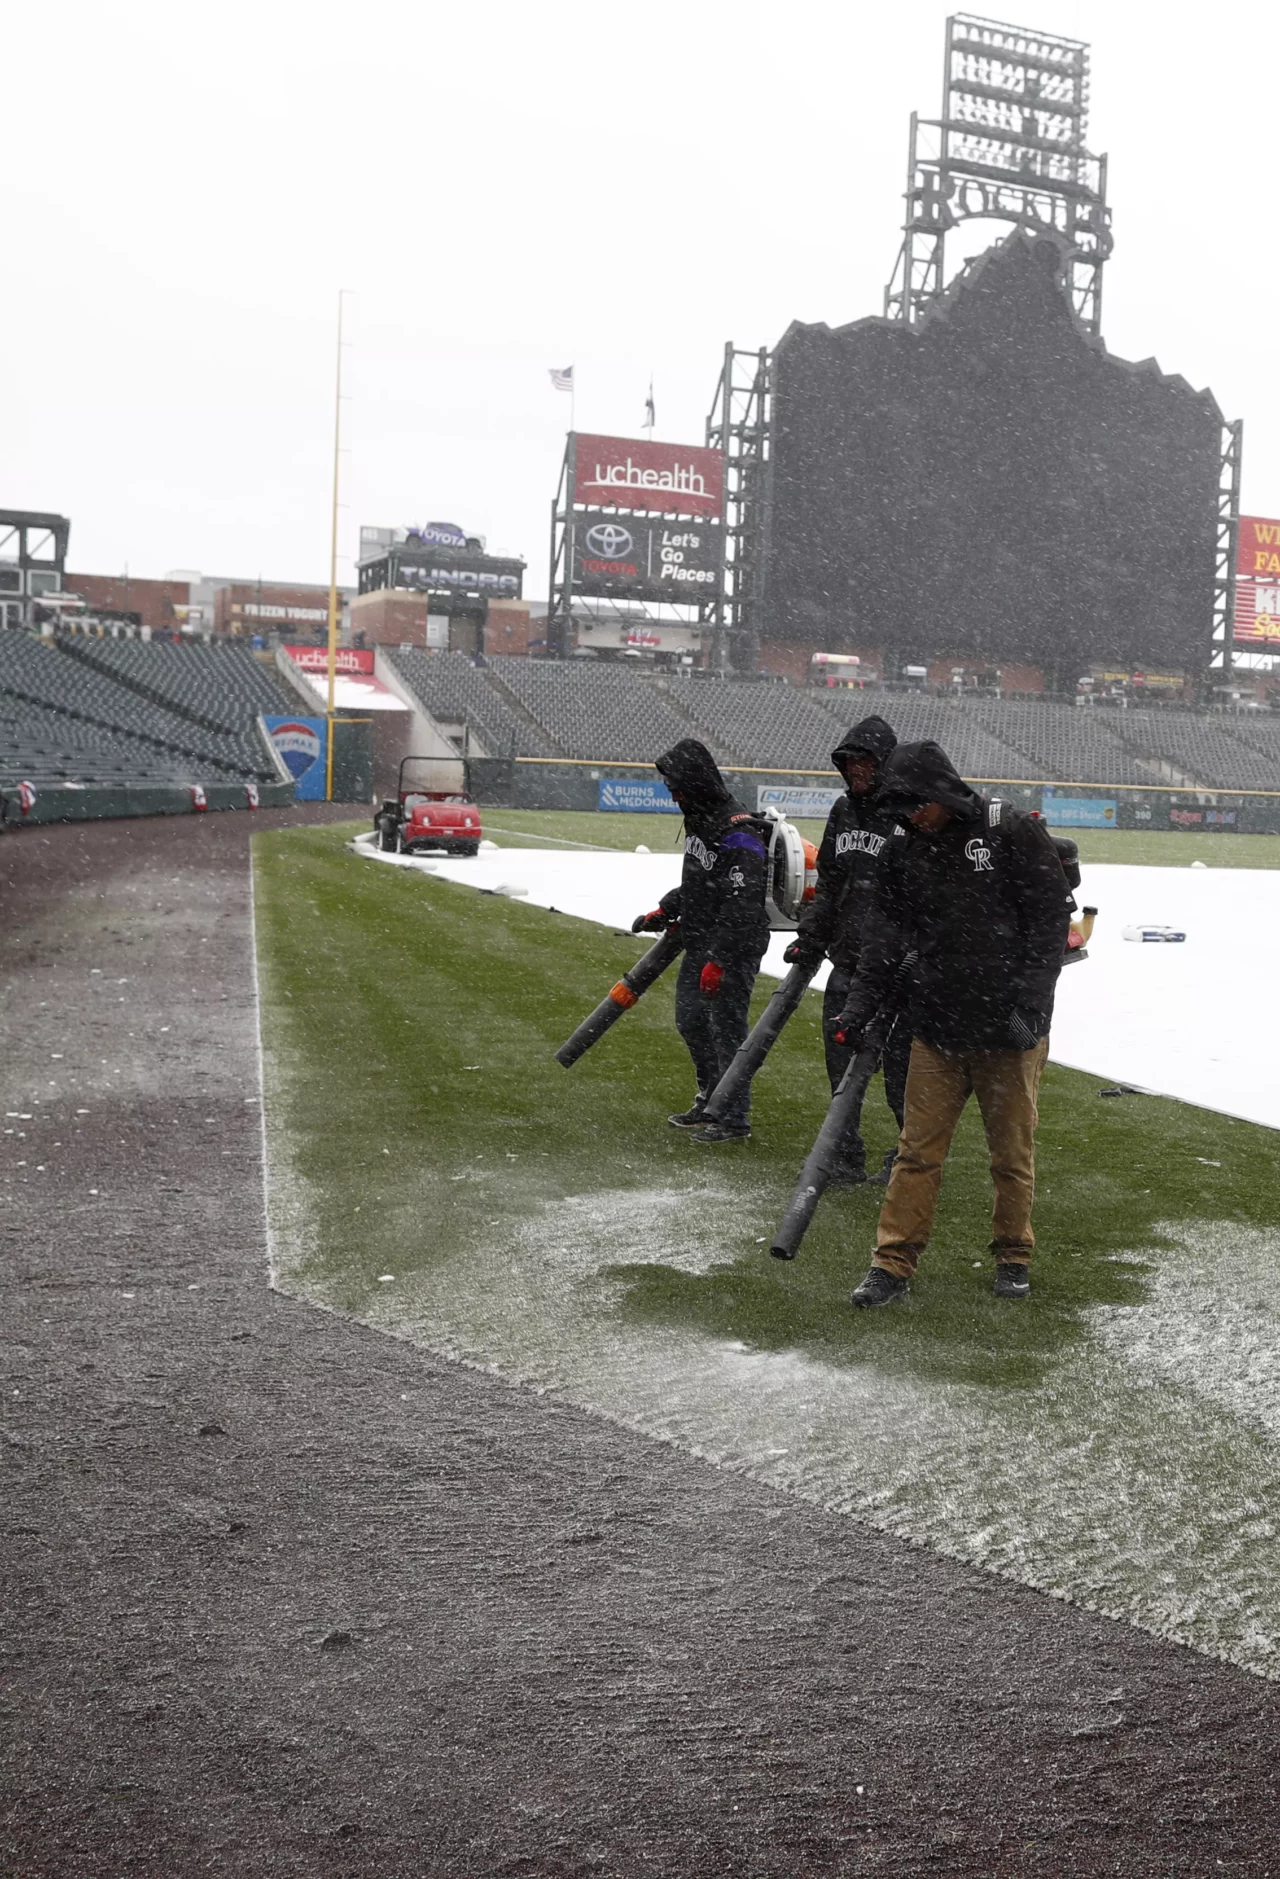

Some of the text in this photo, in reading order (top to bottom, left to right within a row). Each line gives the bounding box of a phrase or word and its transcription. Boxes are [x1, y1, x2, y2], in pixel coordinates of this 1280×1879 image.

[595, 457, 705, 494] uchealth
[418, 528, 467, 547] TOYOTA
[661, 531, 700, 548] Let's
[660, 547, 684, 563] Go
[582, 559, 638, 576] TOYOTA
[660, 564, 716, 583] Places
[399, 566, 519, 589] TUNDRA
[615, 786, 654, 798] BURNS
[1135, 810, 1151, 820] 390
[964, 838, 995, 872] CR
